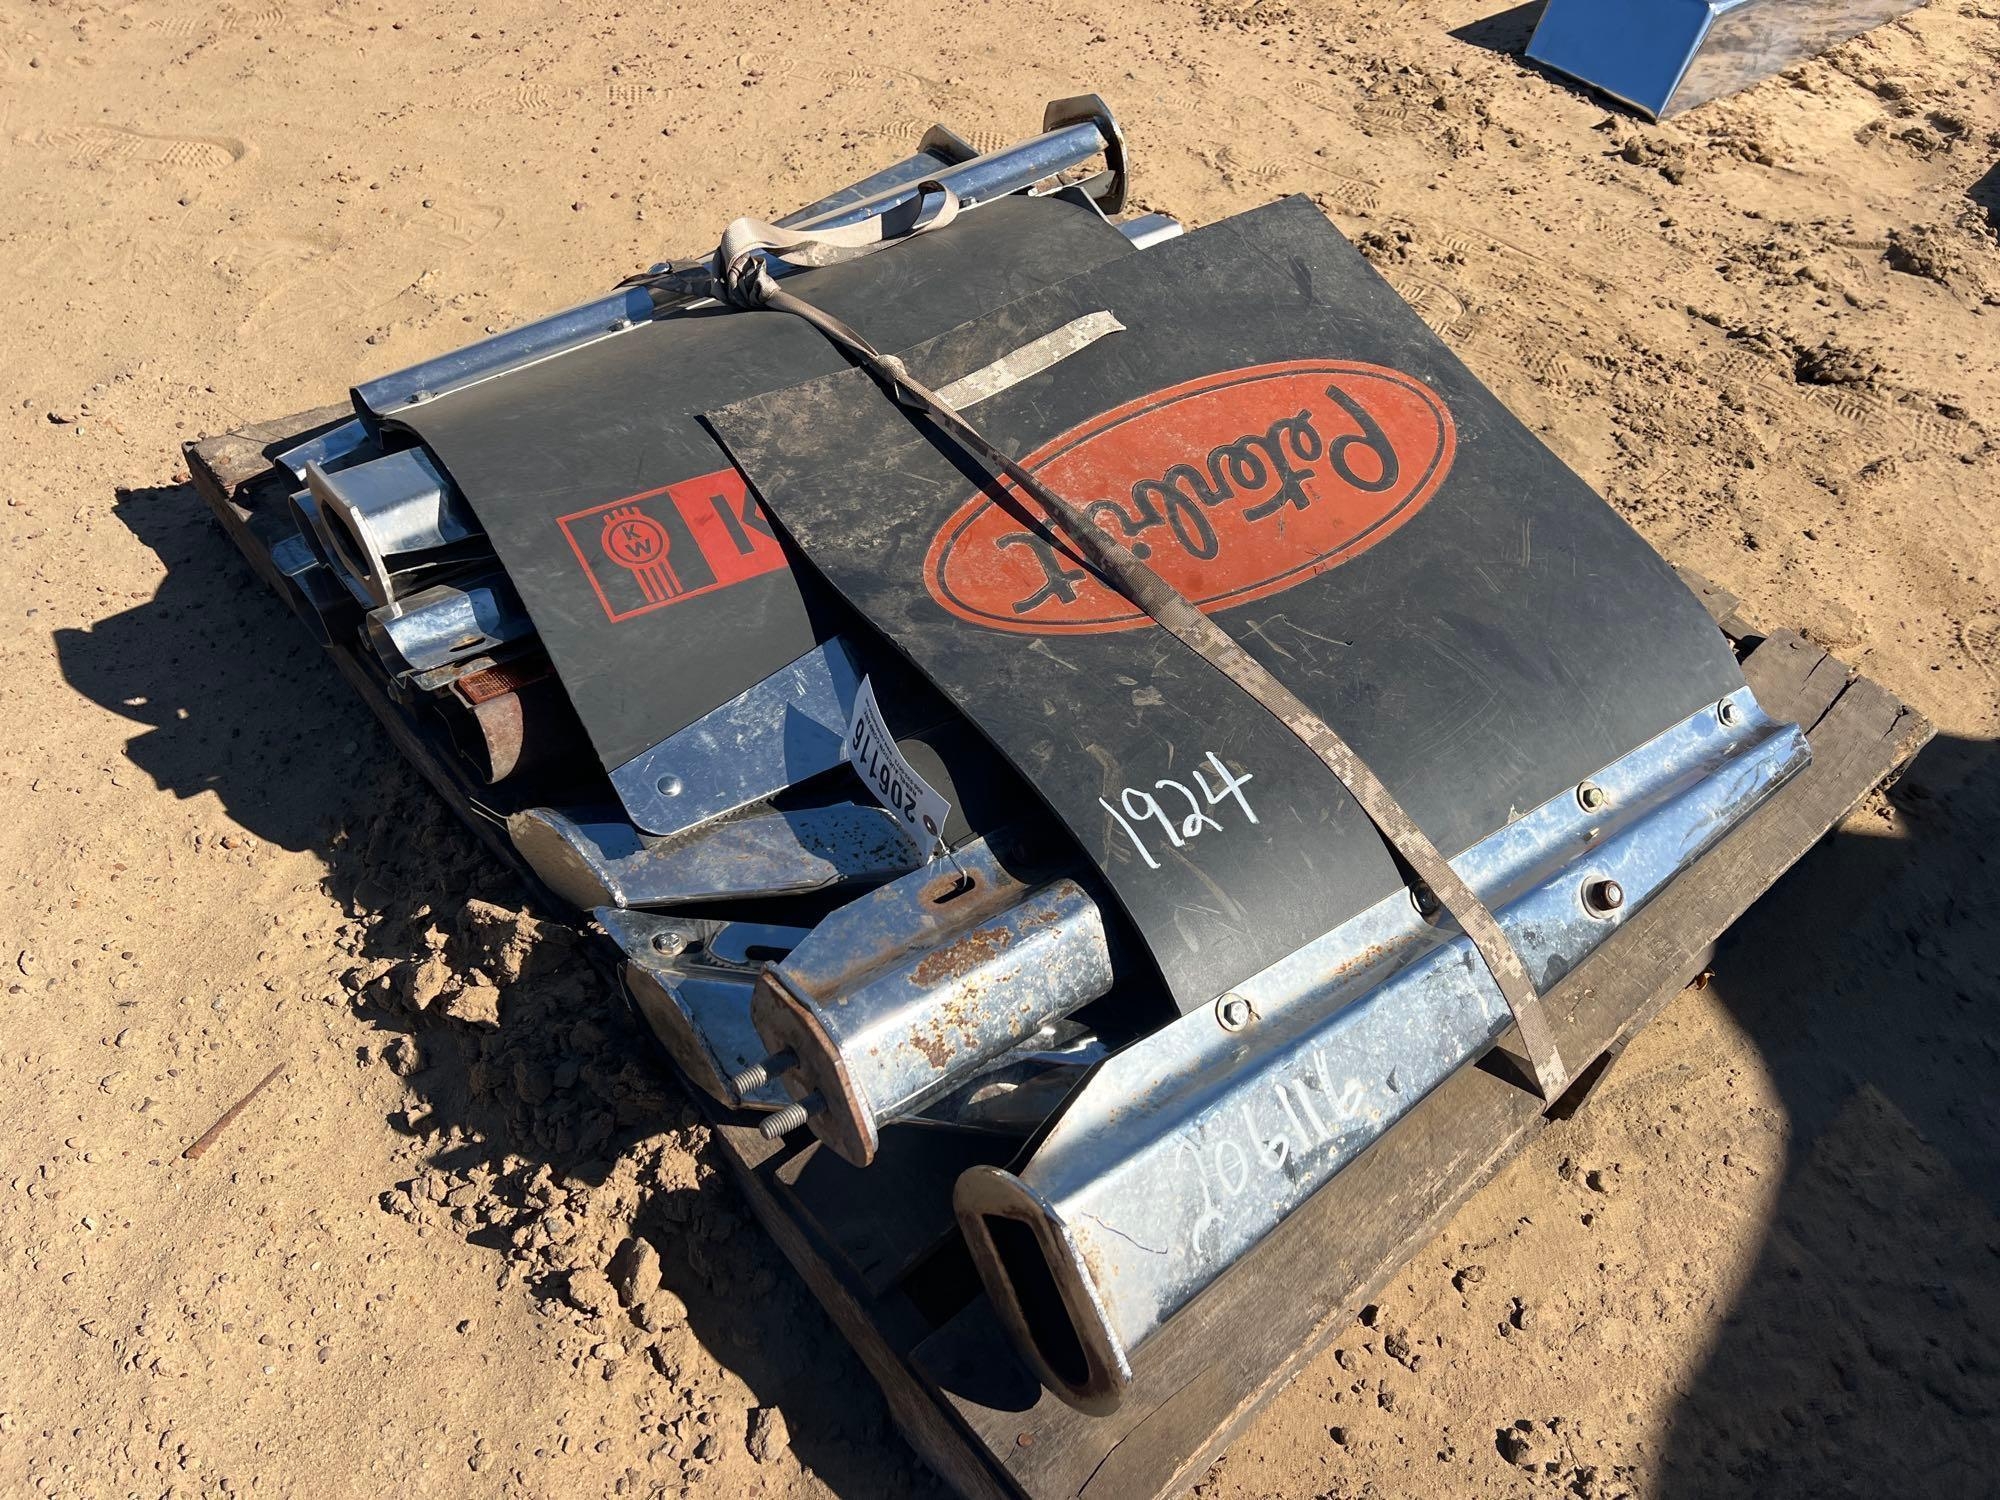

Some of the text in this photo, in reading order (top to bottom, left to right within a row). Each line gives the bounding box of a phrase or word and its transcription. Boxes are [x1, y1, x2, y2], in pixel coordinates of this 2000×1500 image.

[997, 384, 1399, 614] Peterbit
[852, 718, 917, 823] 206116
[863, 710, 918, 797] REBEL AUCTION COMPANY
[1098, 751, 1260, 869] 1924
[1174, 1048, 1366, 1254] 206116
